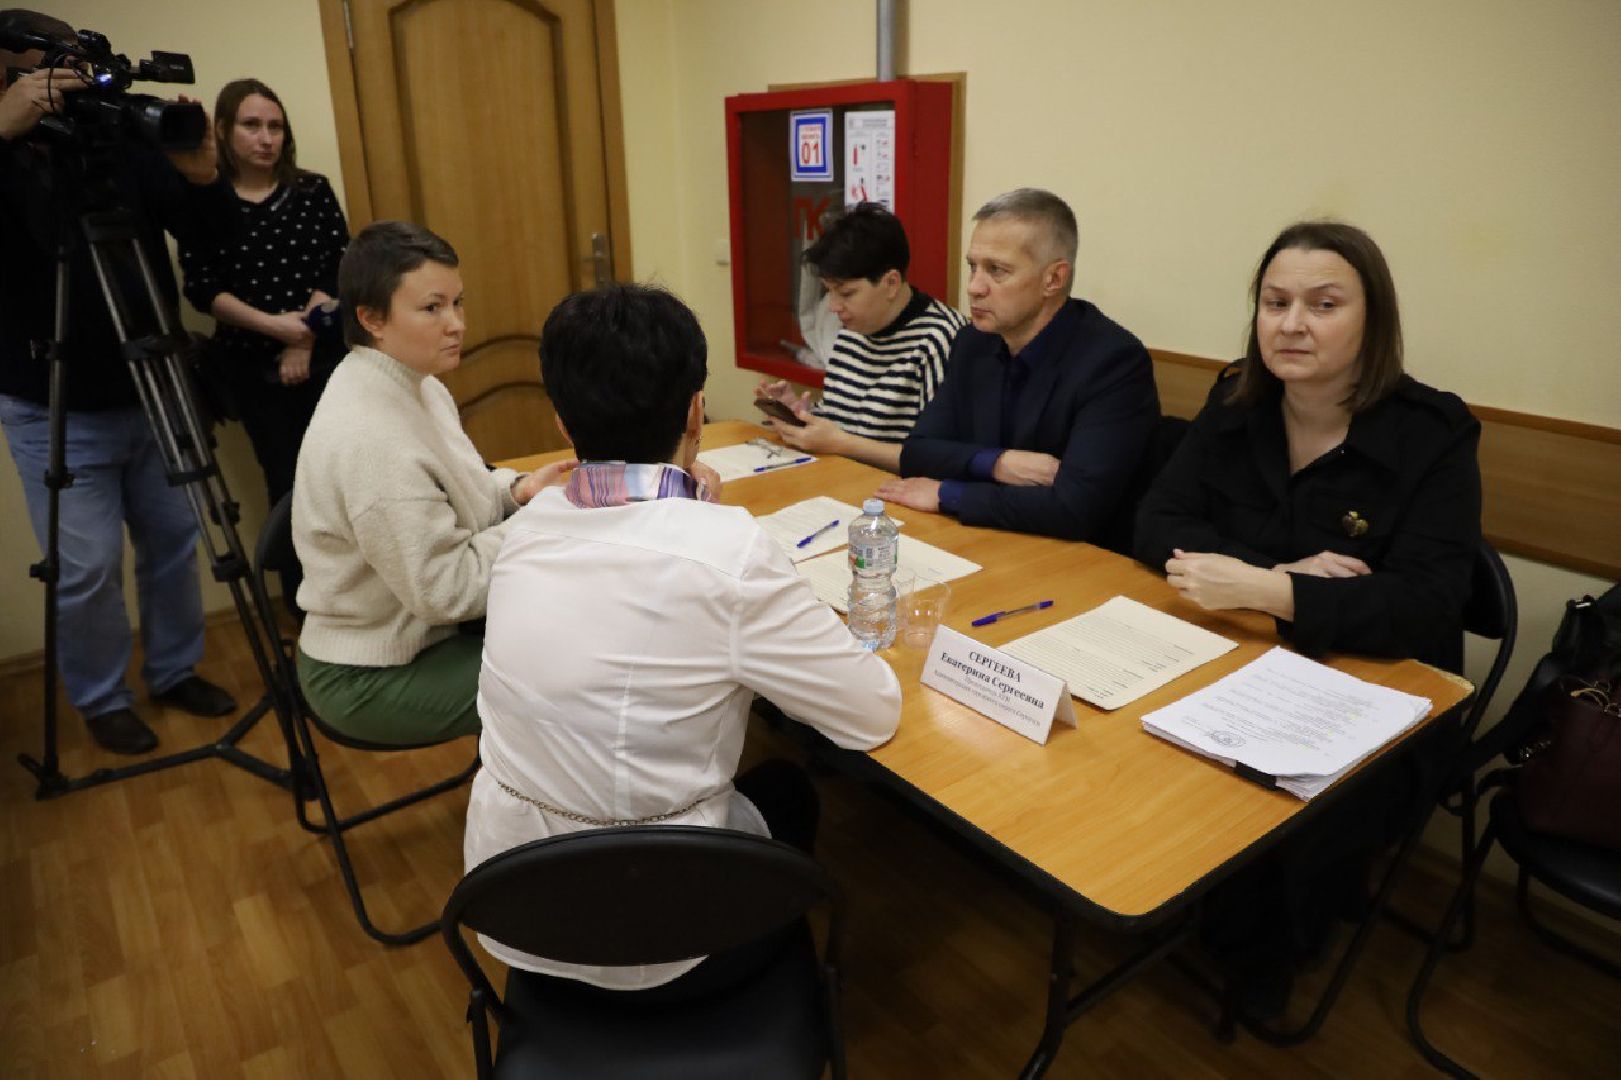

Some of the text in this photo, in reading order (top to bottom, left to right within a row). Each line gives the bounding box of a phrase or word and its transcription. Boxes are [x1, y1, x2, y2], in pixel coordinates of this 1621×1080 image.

[801, 142, 820, 164] 01
[941, 652, 990, 684] Екатерина
[991, 676, 1044, 709] Сергеевна
[969, 651, 1021, 683] СЕРГЕЕВА
